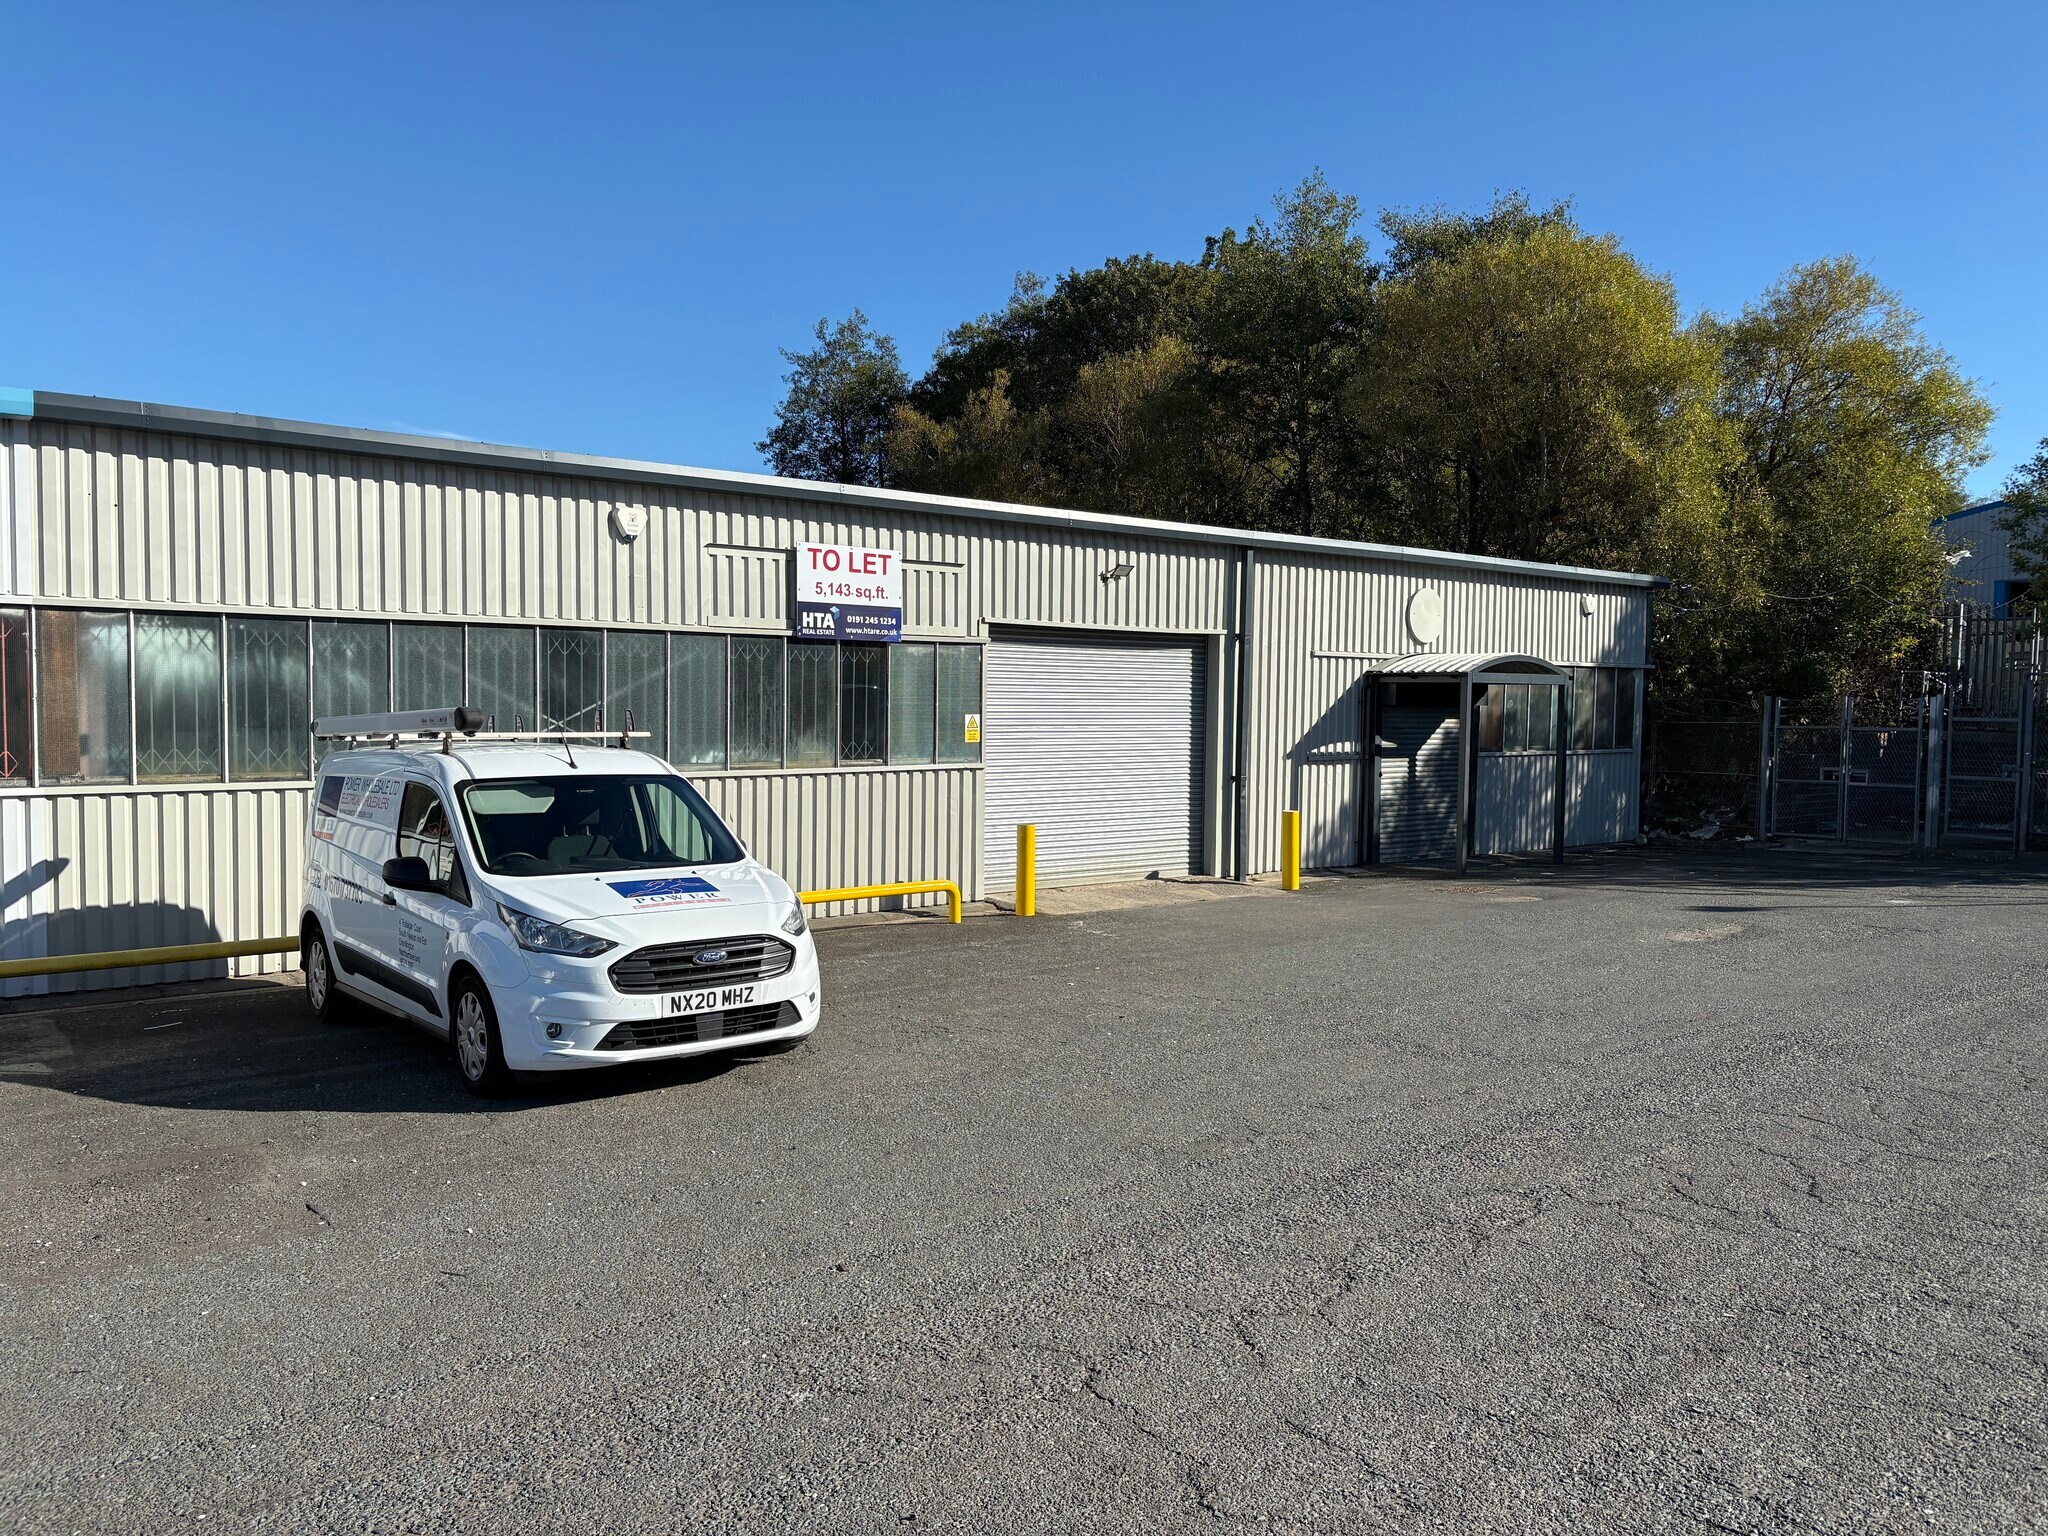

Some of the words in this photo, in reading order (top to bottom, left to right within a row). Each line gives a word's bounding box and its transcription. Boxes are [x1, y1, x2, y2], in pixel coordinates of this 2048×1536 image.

[807, 547, 840, 572] TO
[848, 551, 892, 575] LET
[815, 581, 851, 597] 5,143
[855, 585, 888, 601] sq.ft.
[802, 611, 835, 629] HTA
[847, 615, 863, 624] 0191
[865, 616, 878, 625] 245
[880, 617, 896, 625] 1234
[817, 628, 835, 636] ESTATE
[845, 627, 897, 636] www.htare.co.uk
[344, 777, 361, 792] POWER
[388, 780, 400, 796] LTD
[635, 891, 718, 904] POWER
[702, 952, 720, 961] Ford
[670, 991, 717, 1014] NX20
[721, 986, 754, 1007] MHZ
